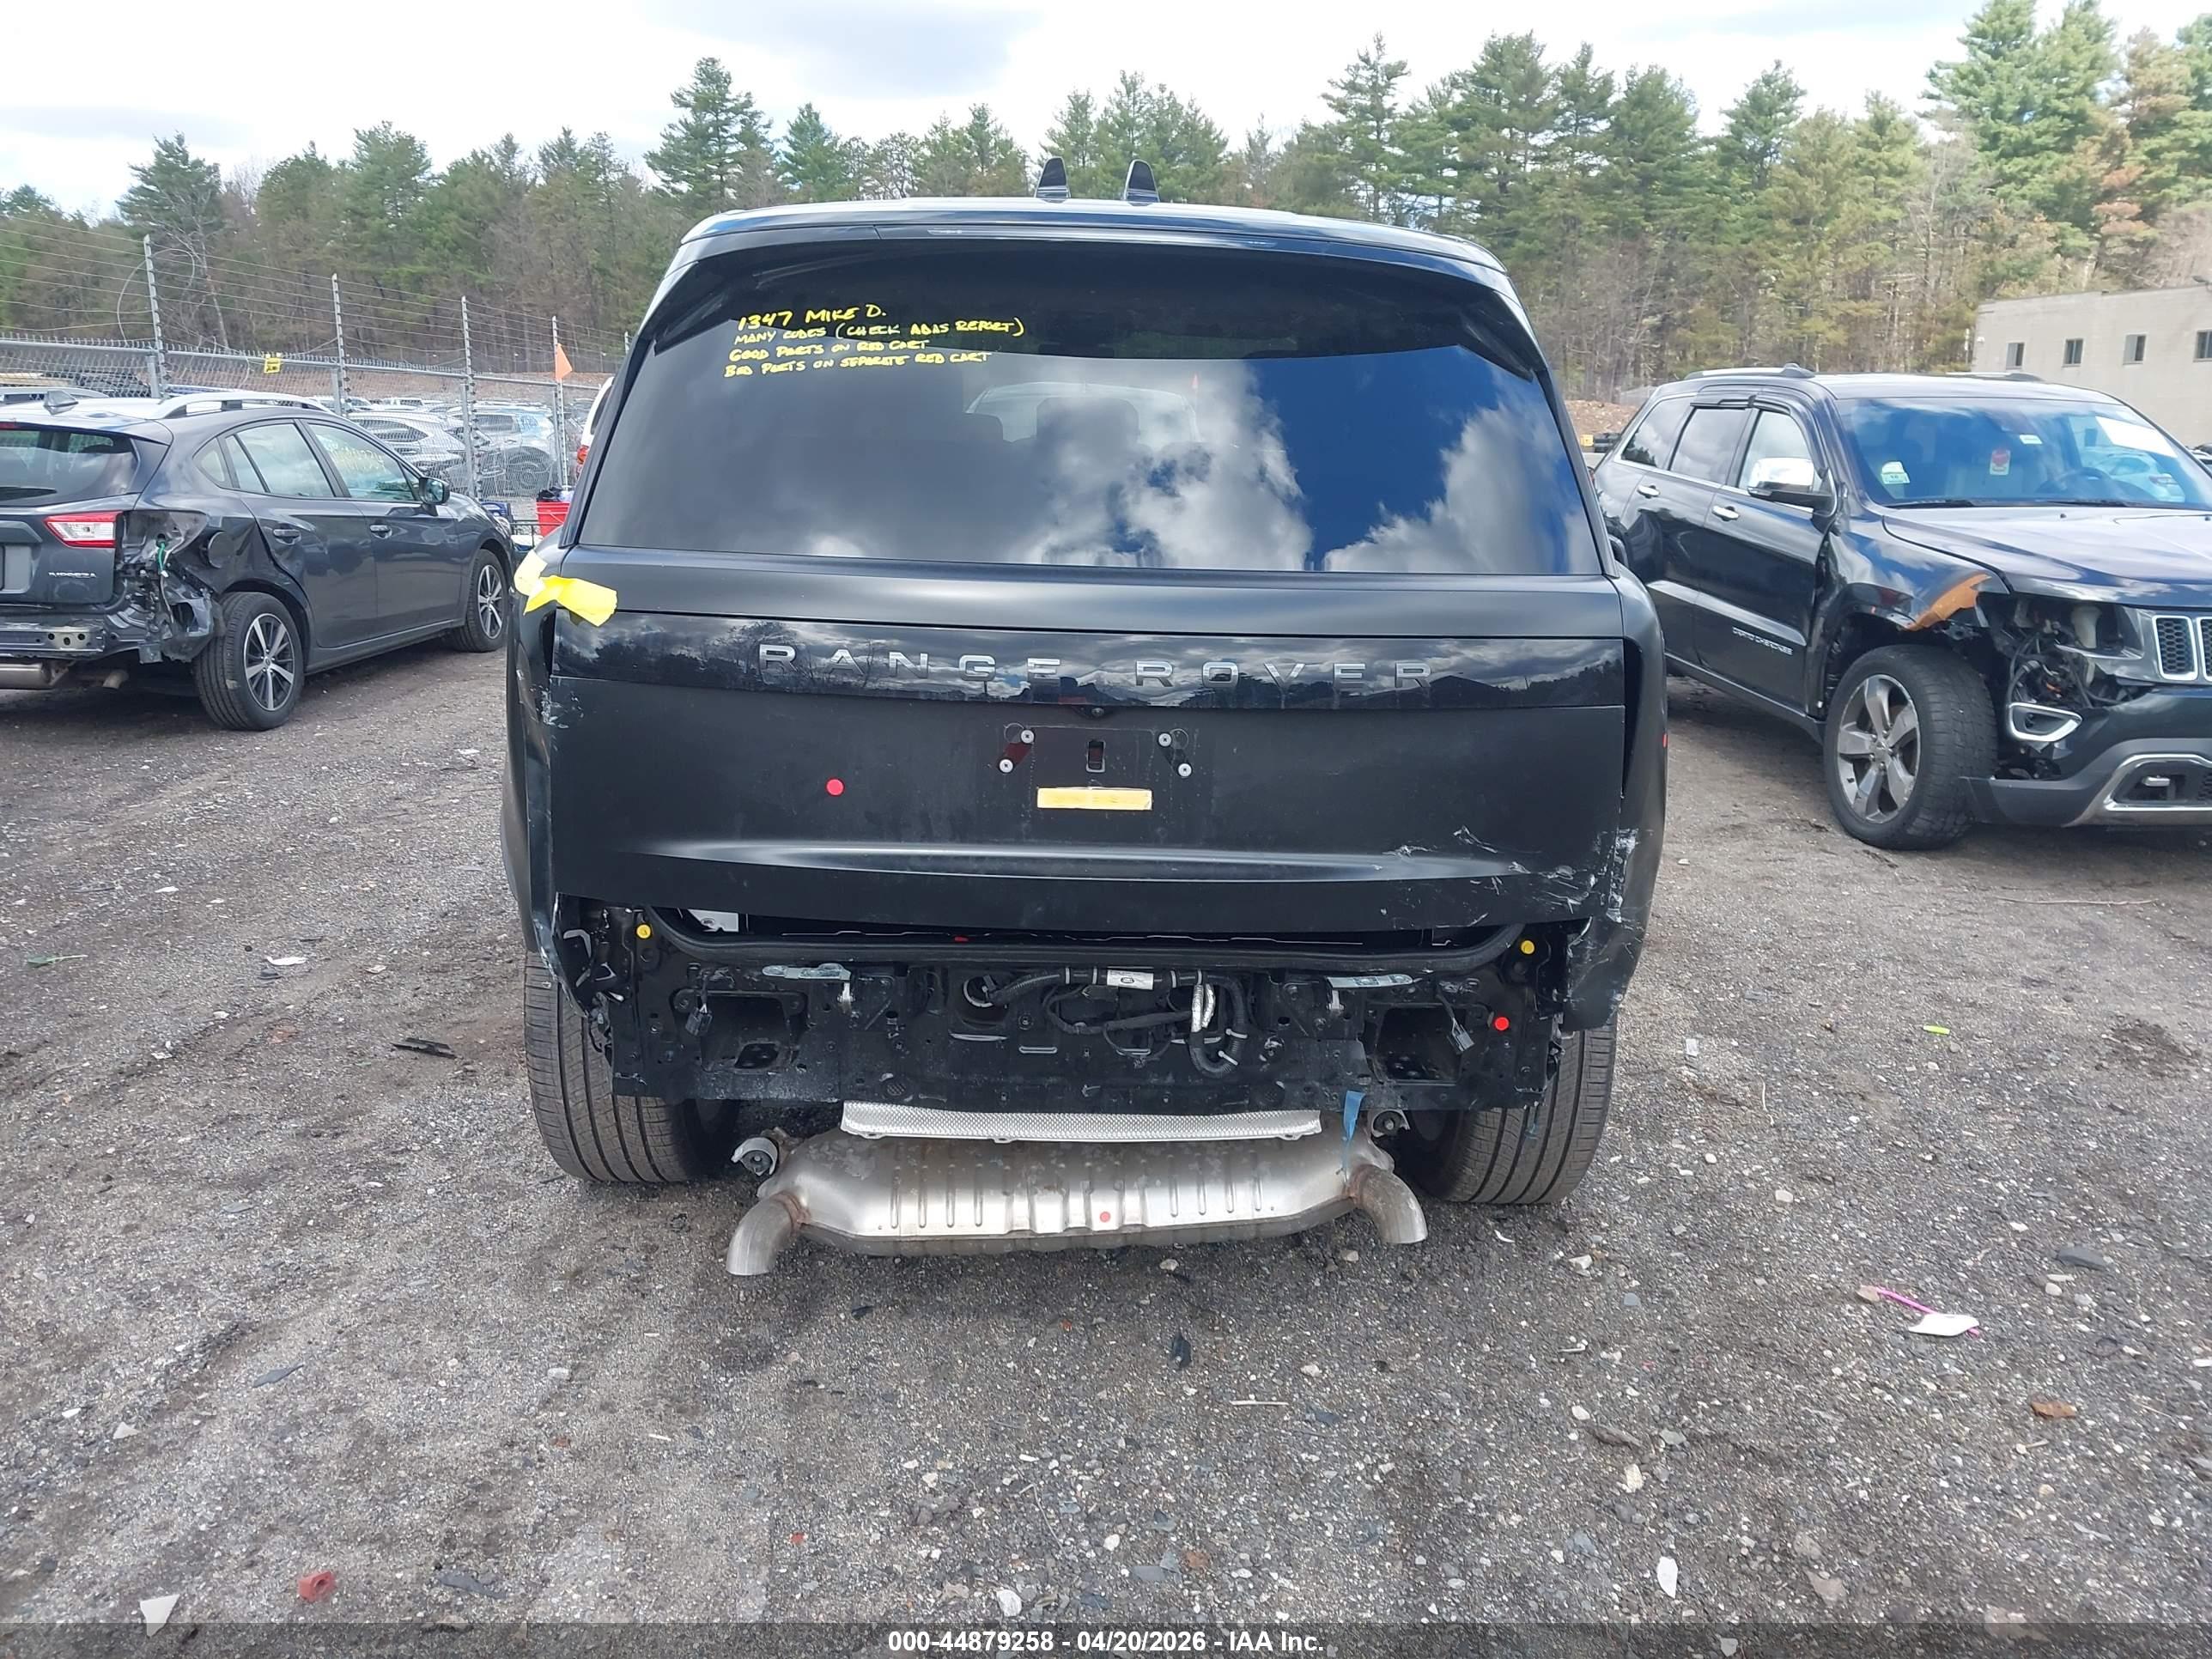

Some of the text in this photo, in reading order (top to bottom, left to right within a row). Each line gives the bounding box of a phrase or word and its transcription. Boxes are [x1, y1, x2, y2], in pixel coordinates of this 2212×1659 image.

[734, 317, 1025, 345] MANY CODES (CHECK ADAS REPORT)
[738, 303, 887, 331] 1347 MIKE D.
[724, 351, 993, 378] BAD PARTS ON SEPARATE RED CART
[729, 339, 930, 362] GOOD PARTS ON RED CART
[758, 643, 1432, 689] RANGE ROVER
